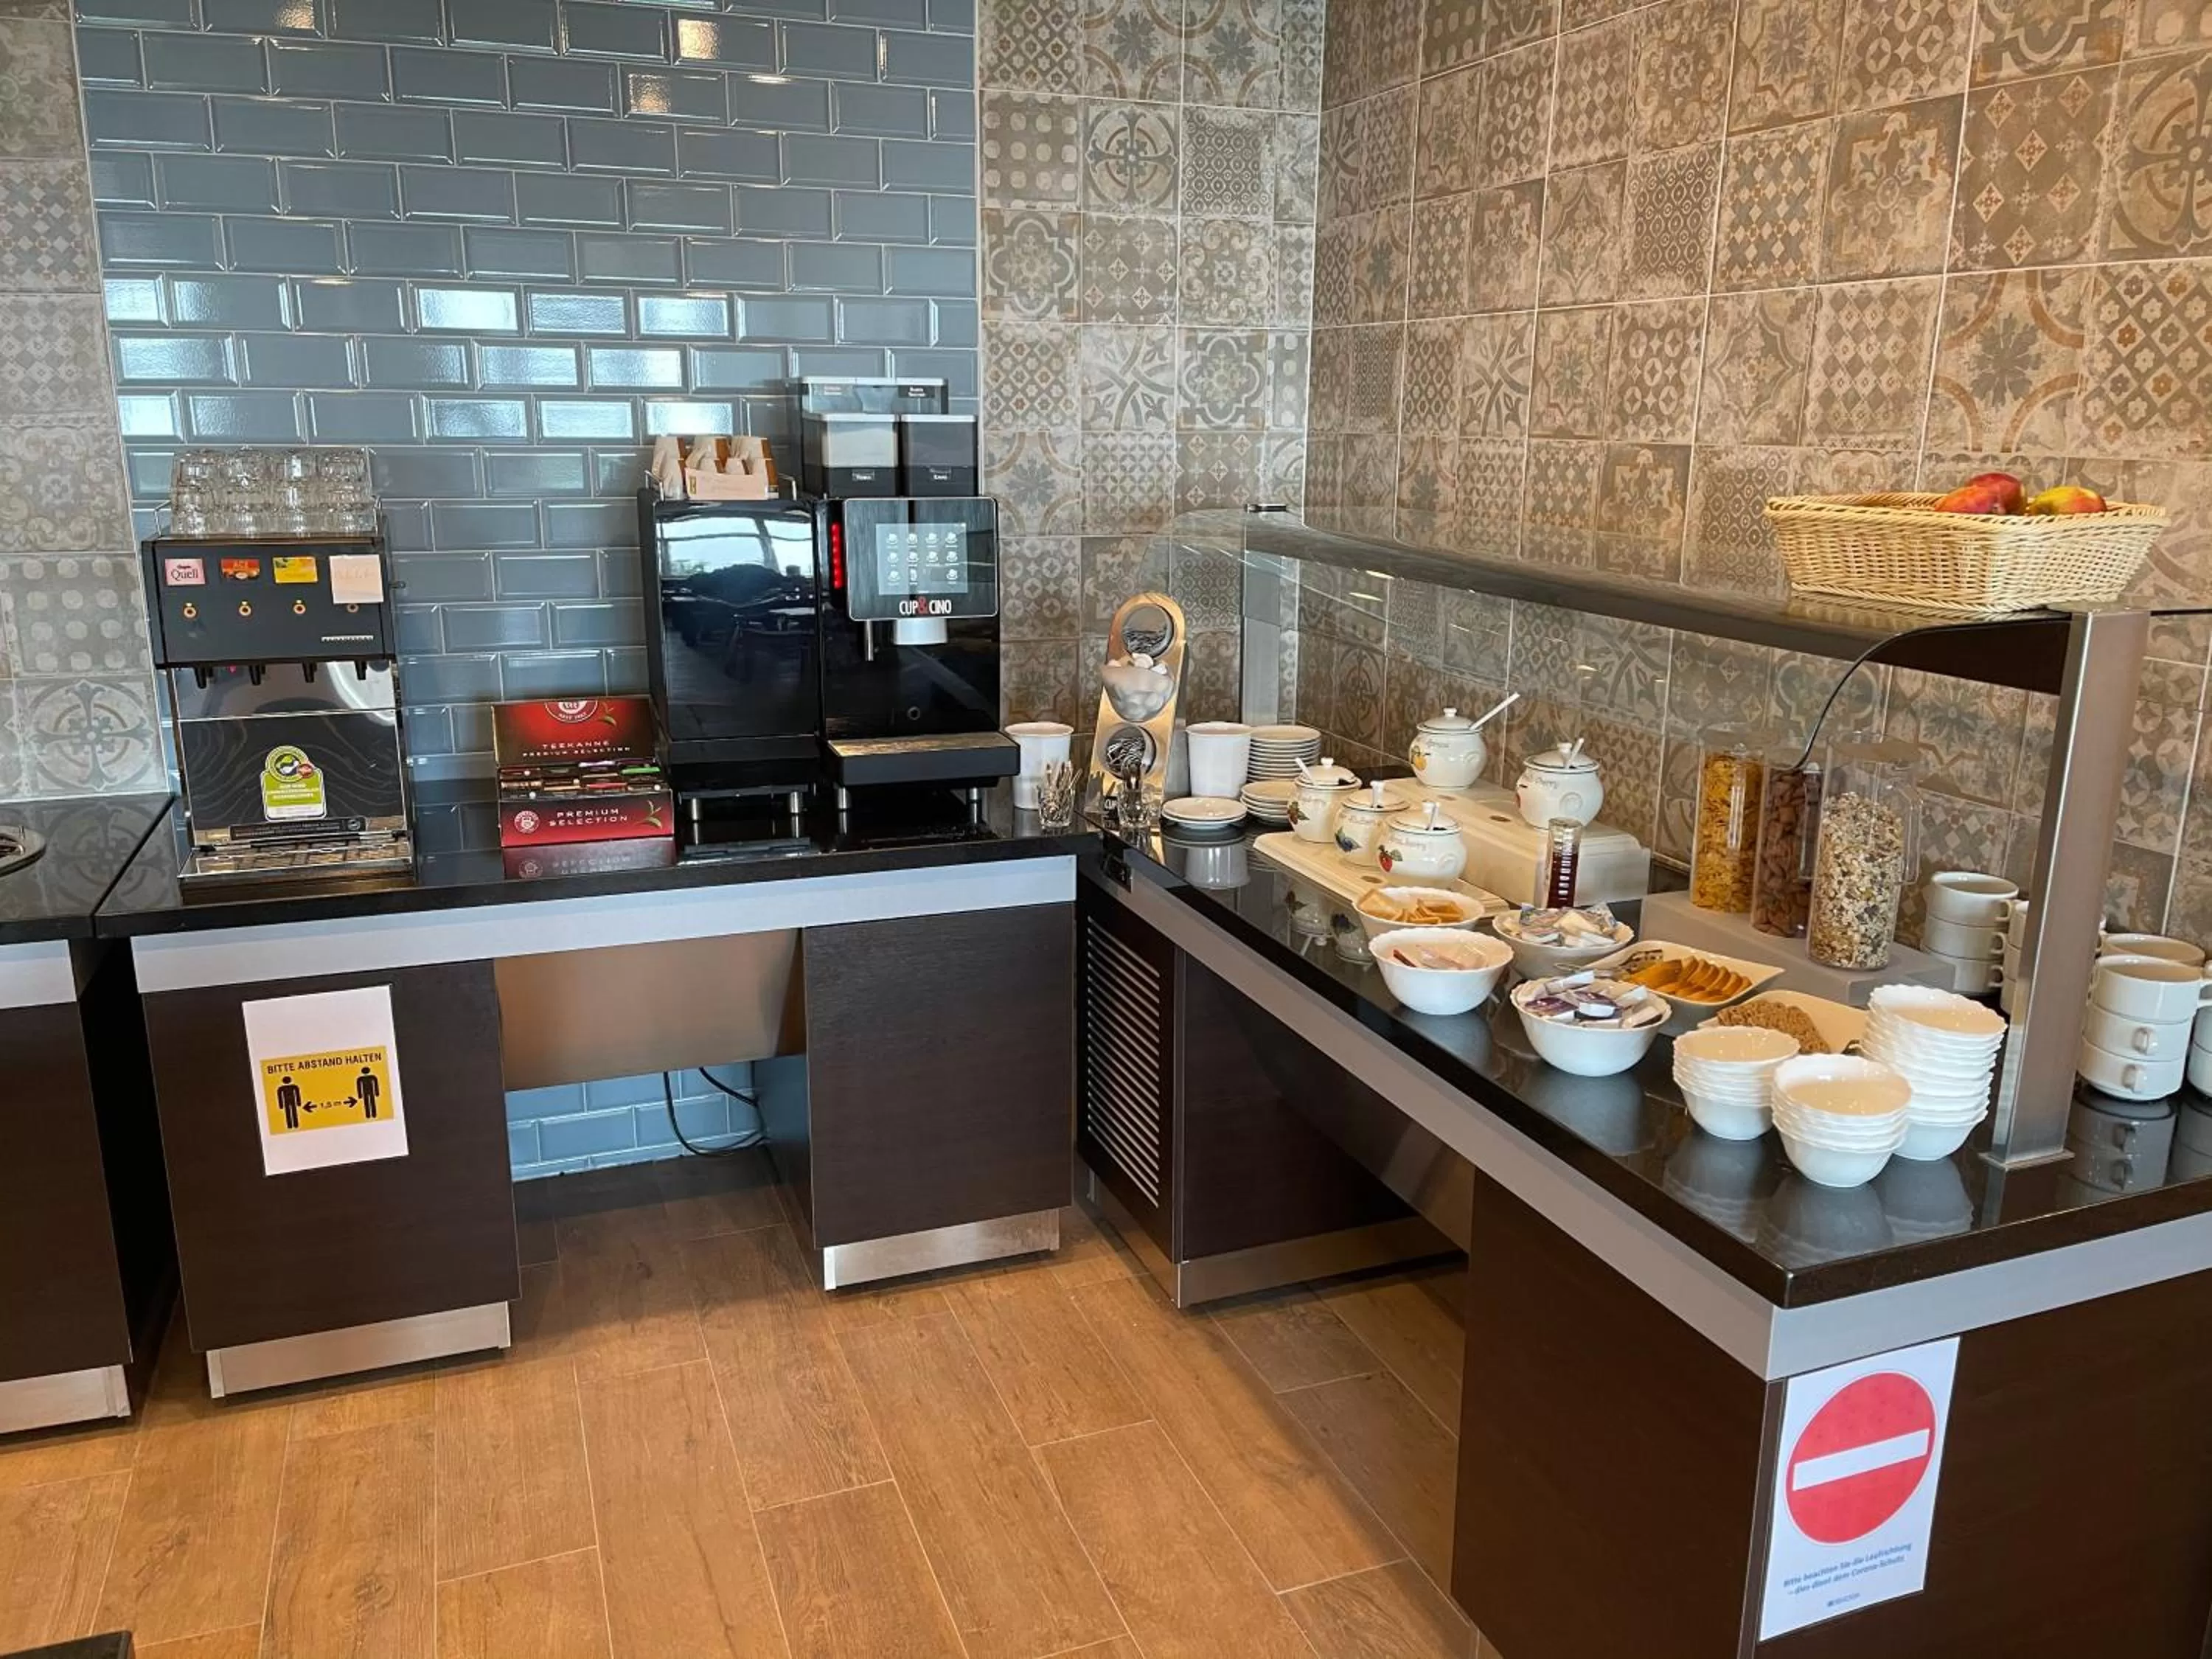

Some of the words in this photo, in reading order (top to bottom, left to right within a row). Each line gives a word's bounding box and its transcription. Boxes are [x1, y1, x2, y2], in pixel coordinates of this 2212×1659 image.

[170, 569, 198, 581] Quell
[542, 740, 611, 750] TEEKANNE
[557, 808, 619, 818] PREMIUM
[549, 815, 628, 827] SELECTION
[266, 1062, 295, 1074] BITTE
[297, 1057, 343, 1071] ABSTAND
[345, 1052, 382, 1065] HALTEN
